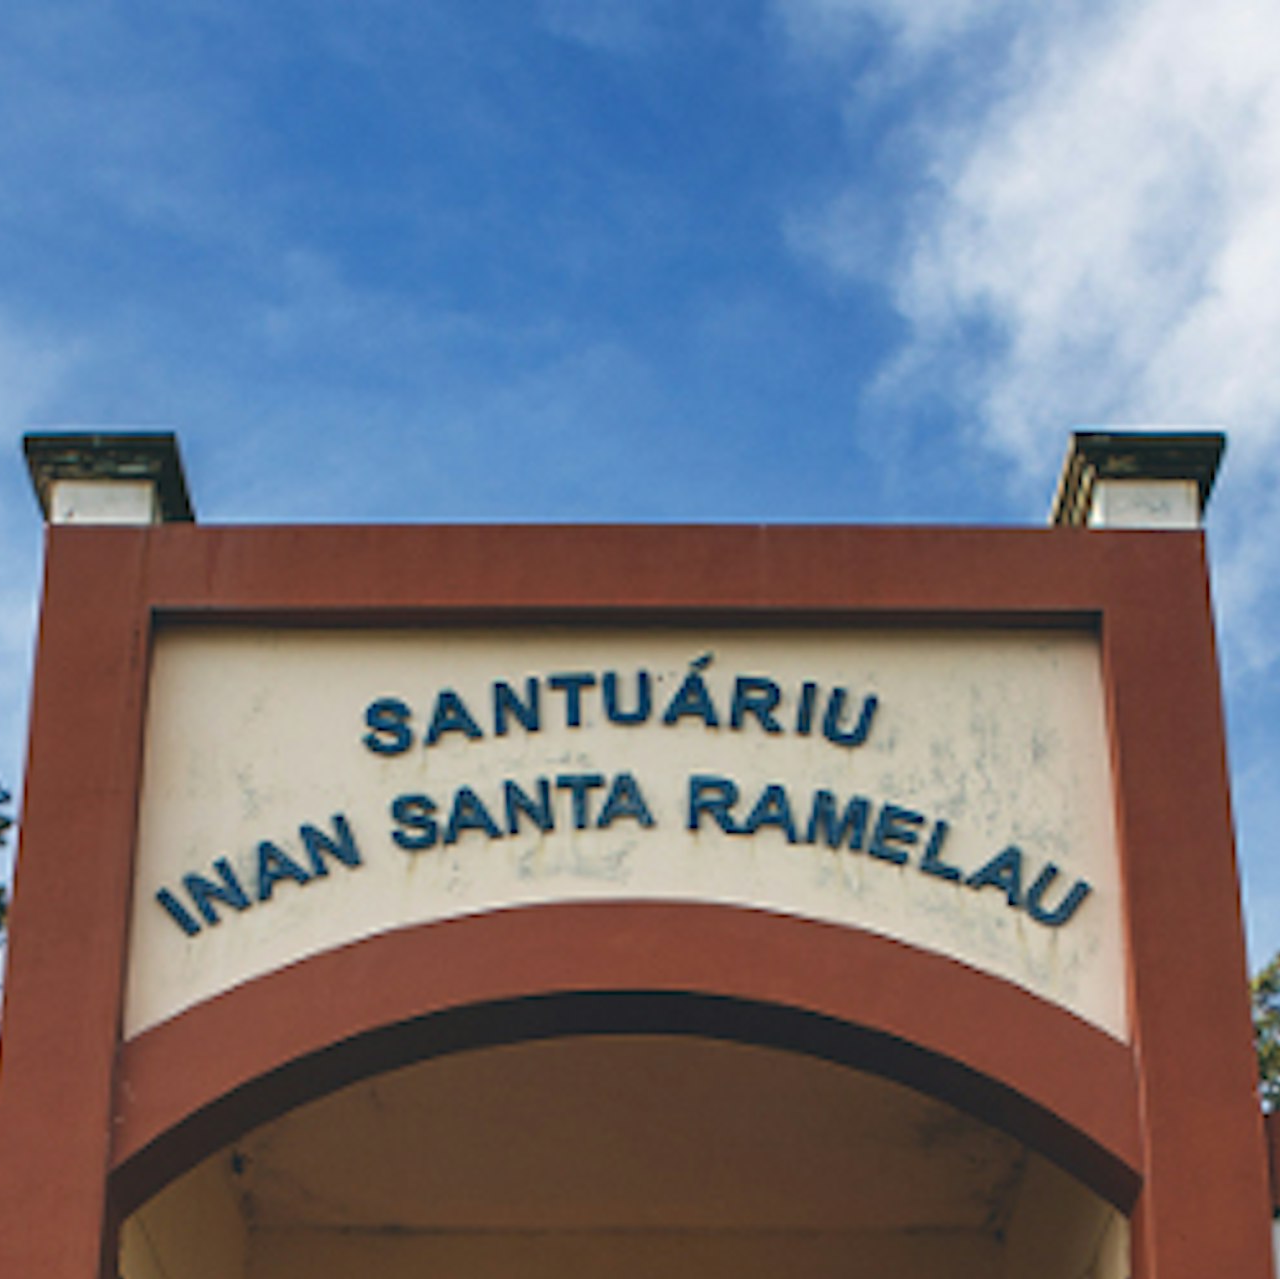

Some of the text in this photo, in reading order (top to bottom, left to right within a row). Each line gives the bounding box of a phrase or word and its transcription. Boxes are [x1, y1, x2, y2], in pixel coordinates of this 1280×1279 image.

[363, 652, 879, 757] SANTUÁRIU
[155, 771, 1093, 938] INAN SANTA RAMELAU
